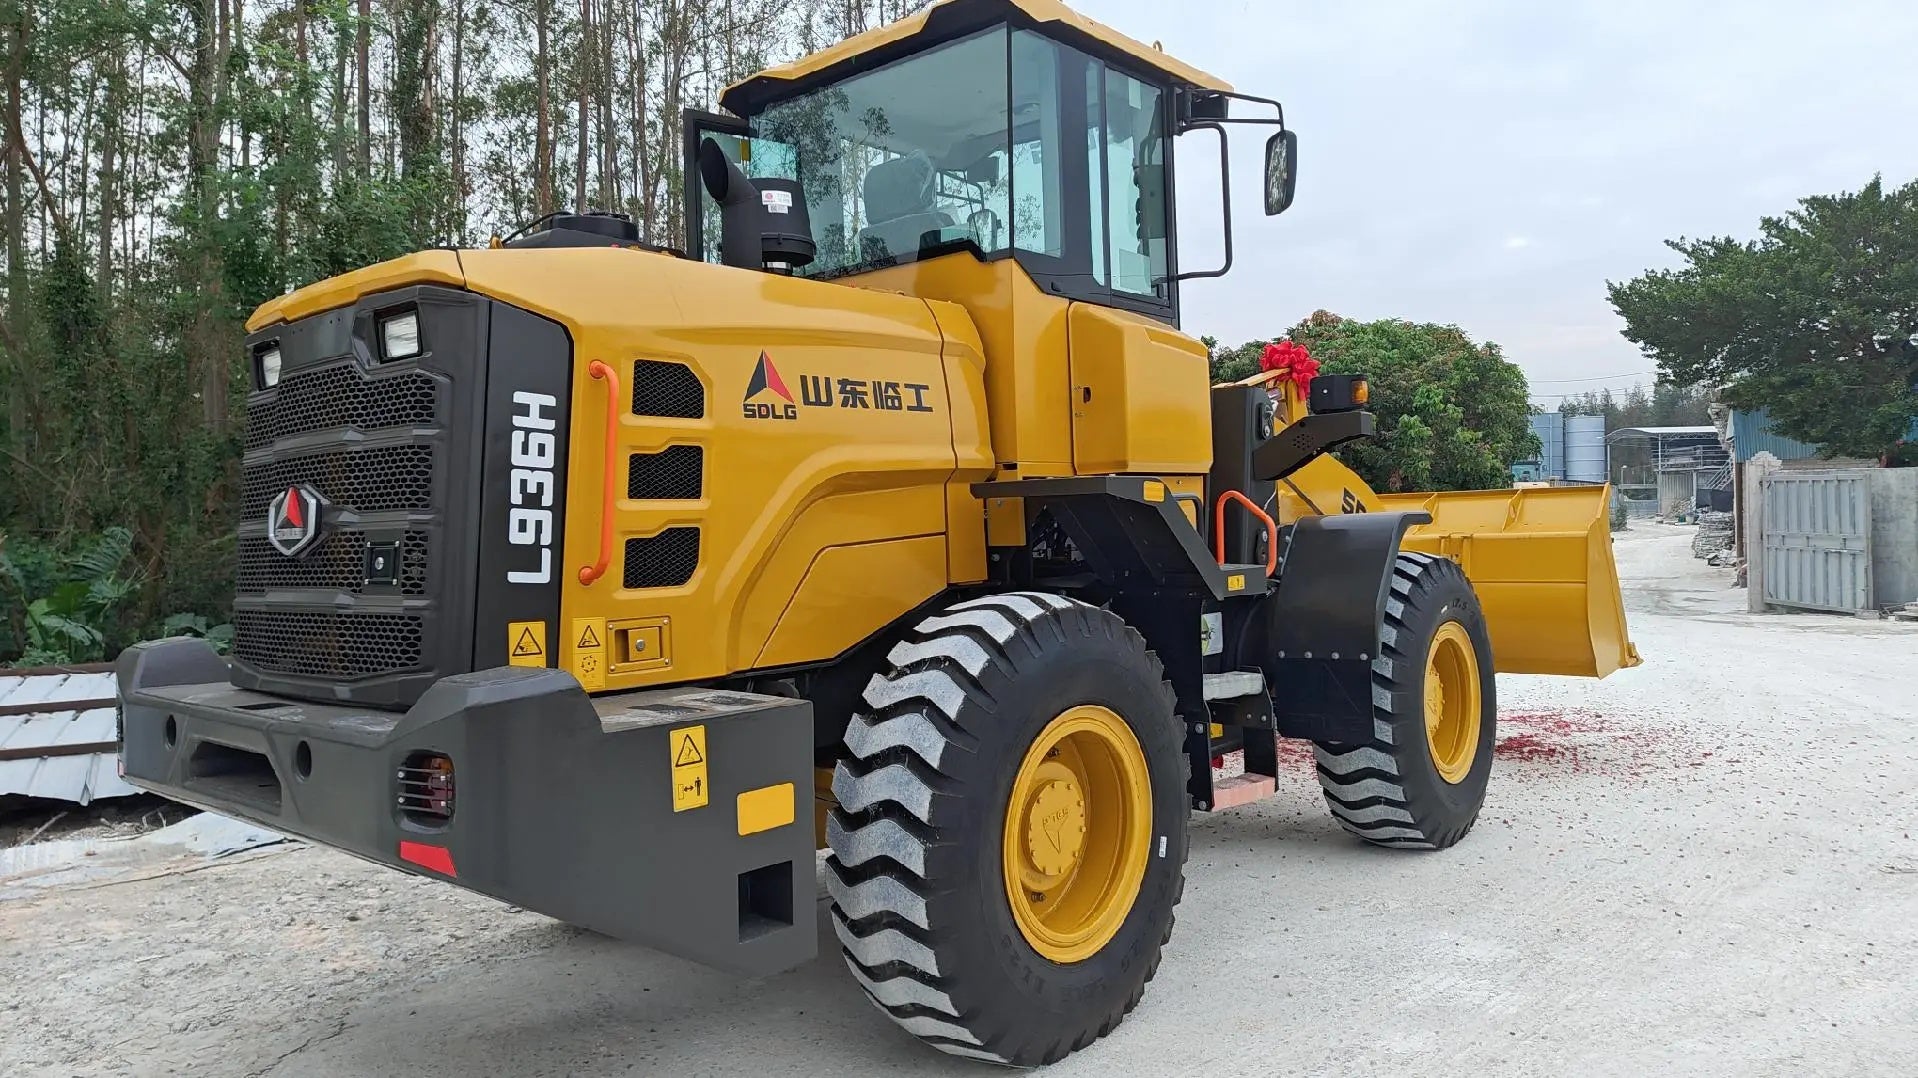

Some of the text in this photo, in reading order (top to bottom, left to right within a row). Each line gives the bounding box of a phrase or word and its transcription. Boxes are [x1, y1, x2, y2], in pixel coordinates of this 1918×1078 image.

[743, 403, 797, 420] SDLG
[800, 375, 933, 412] 山东临工
[507, 390, 557, 584] L936H
